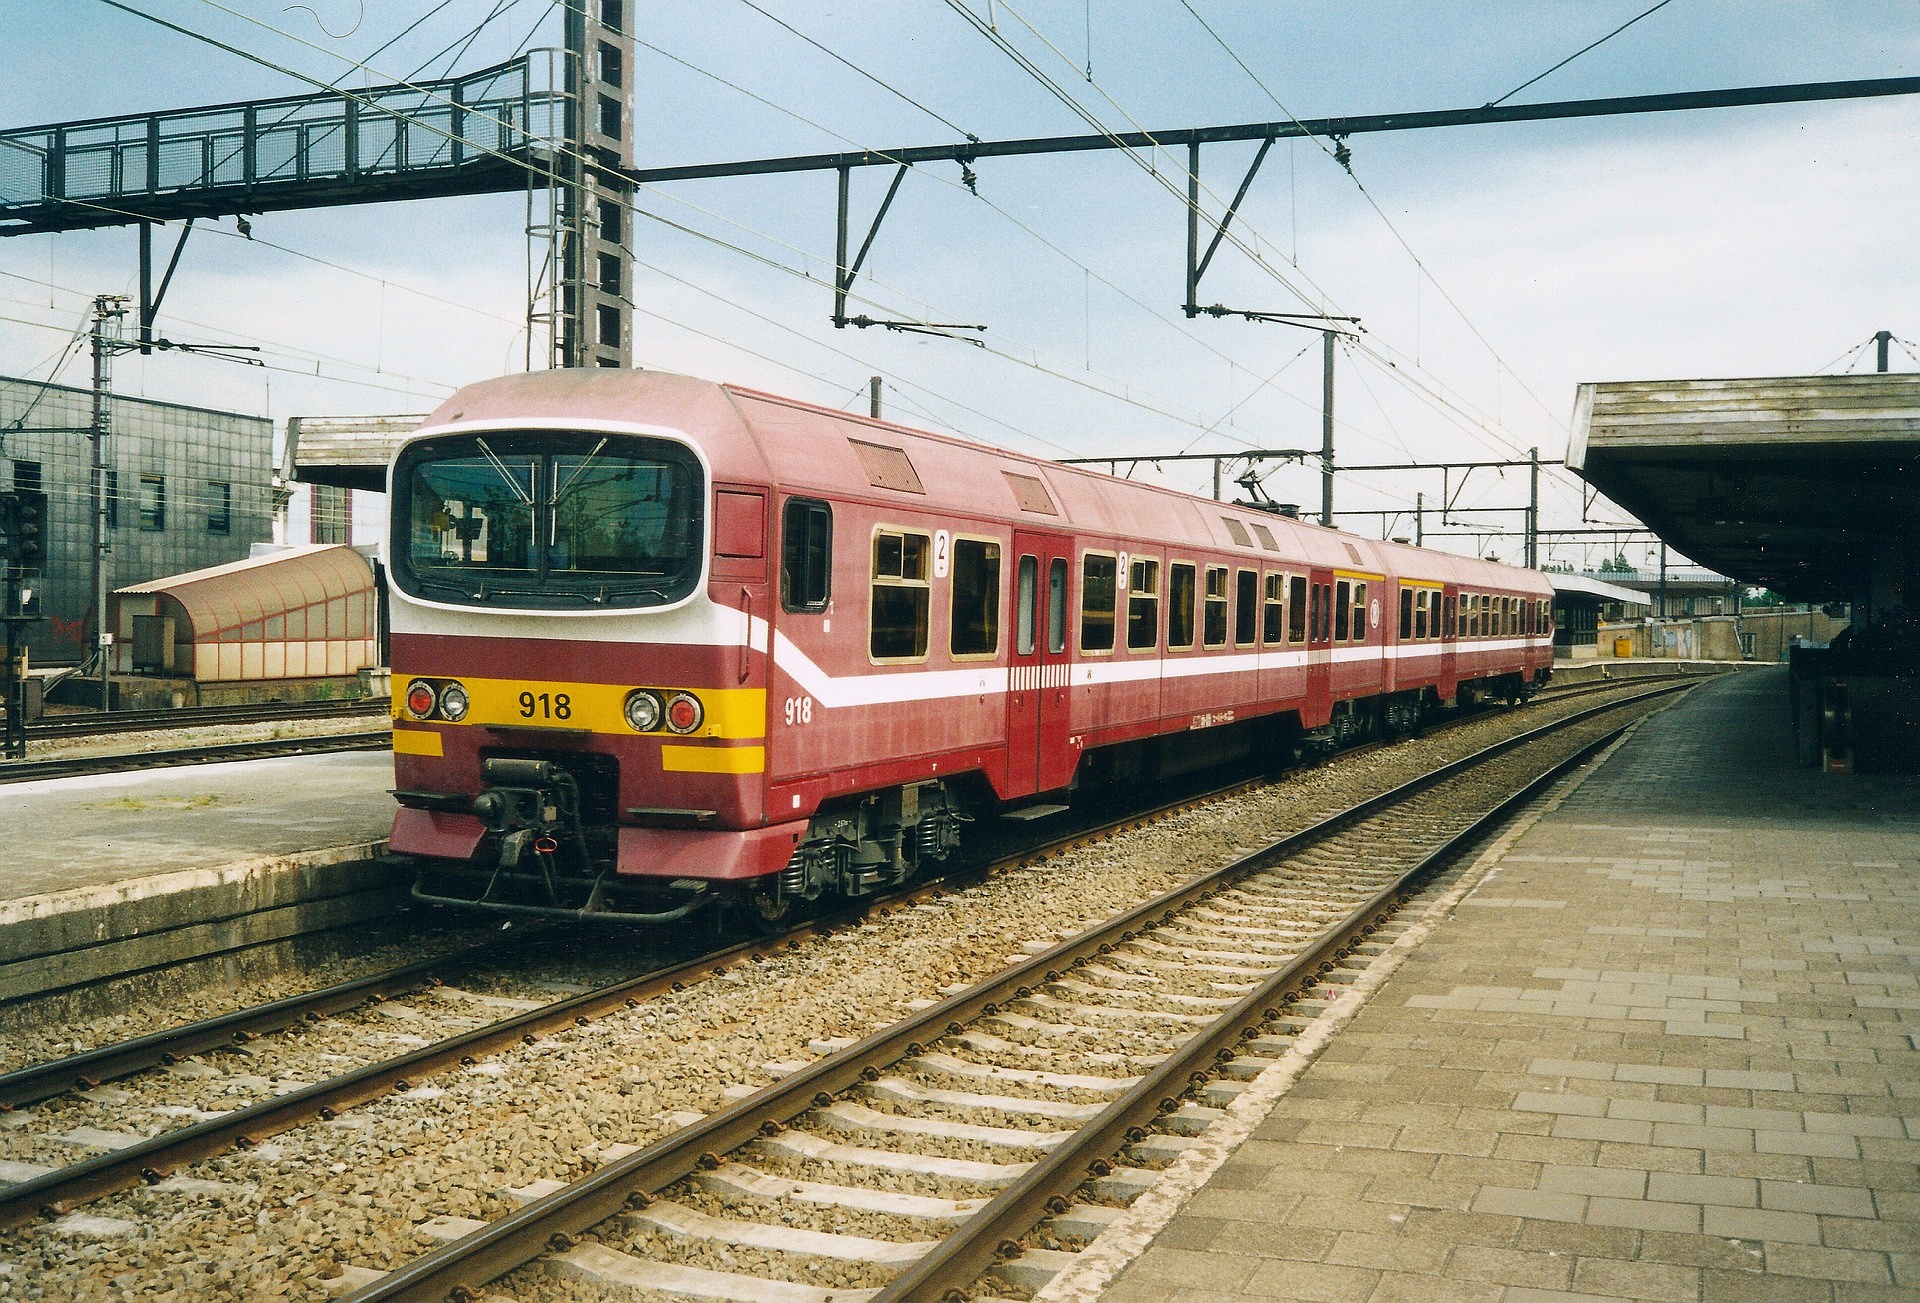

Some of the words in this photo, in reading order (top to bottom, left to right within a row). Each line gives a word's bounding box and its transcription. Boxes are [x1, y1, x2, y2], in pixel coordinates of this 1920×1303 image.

[938, 535, 946, 560] 2
[519, 691, 571, 720] 918
[785, 696, 812, 726] 918
